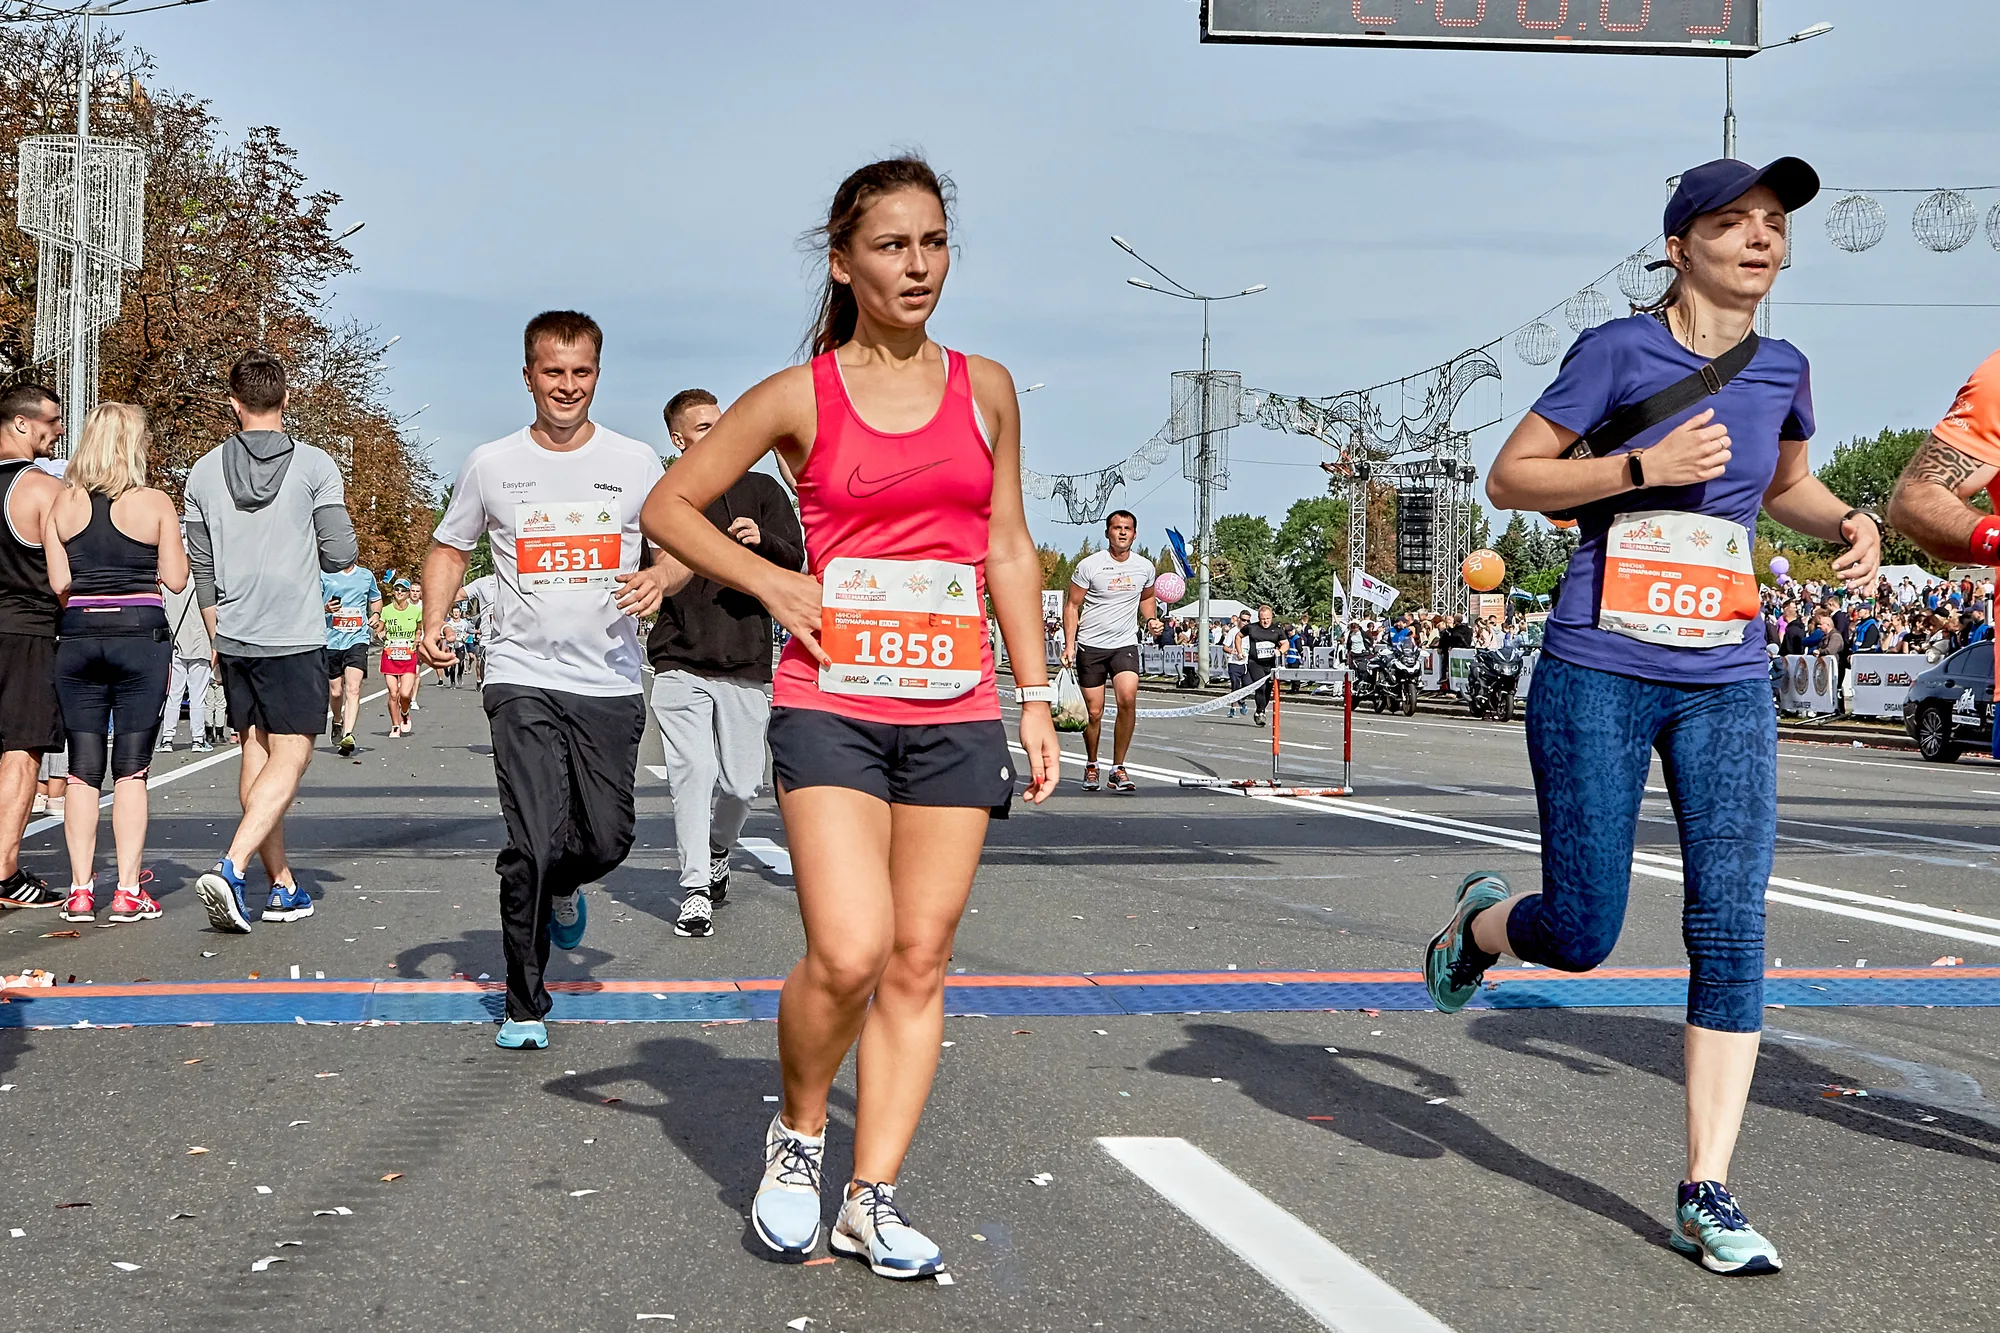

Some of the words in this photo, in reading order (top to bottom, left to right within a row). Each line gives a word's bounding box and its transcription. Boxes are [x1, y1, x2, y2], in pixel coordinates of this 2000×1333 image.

[503, 480, 536, 489] Easybrain
[594, 482, 622, 493] adidas
[538, 548, 602, 571] 4531
[1648, 582, 1722, 618] 668
[388, 618, 397, 626] WE
[854, 631, 954, 667] 1858
